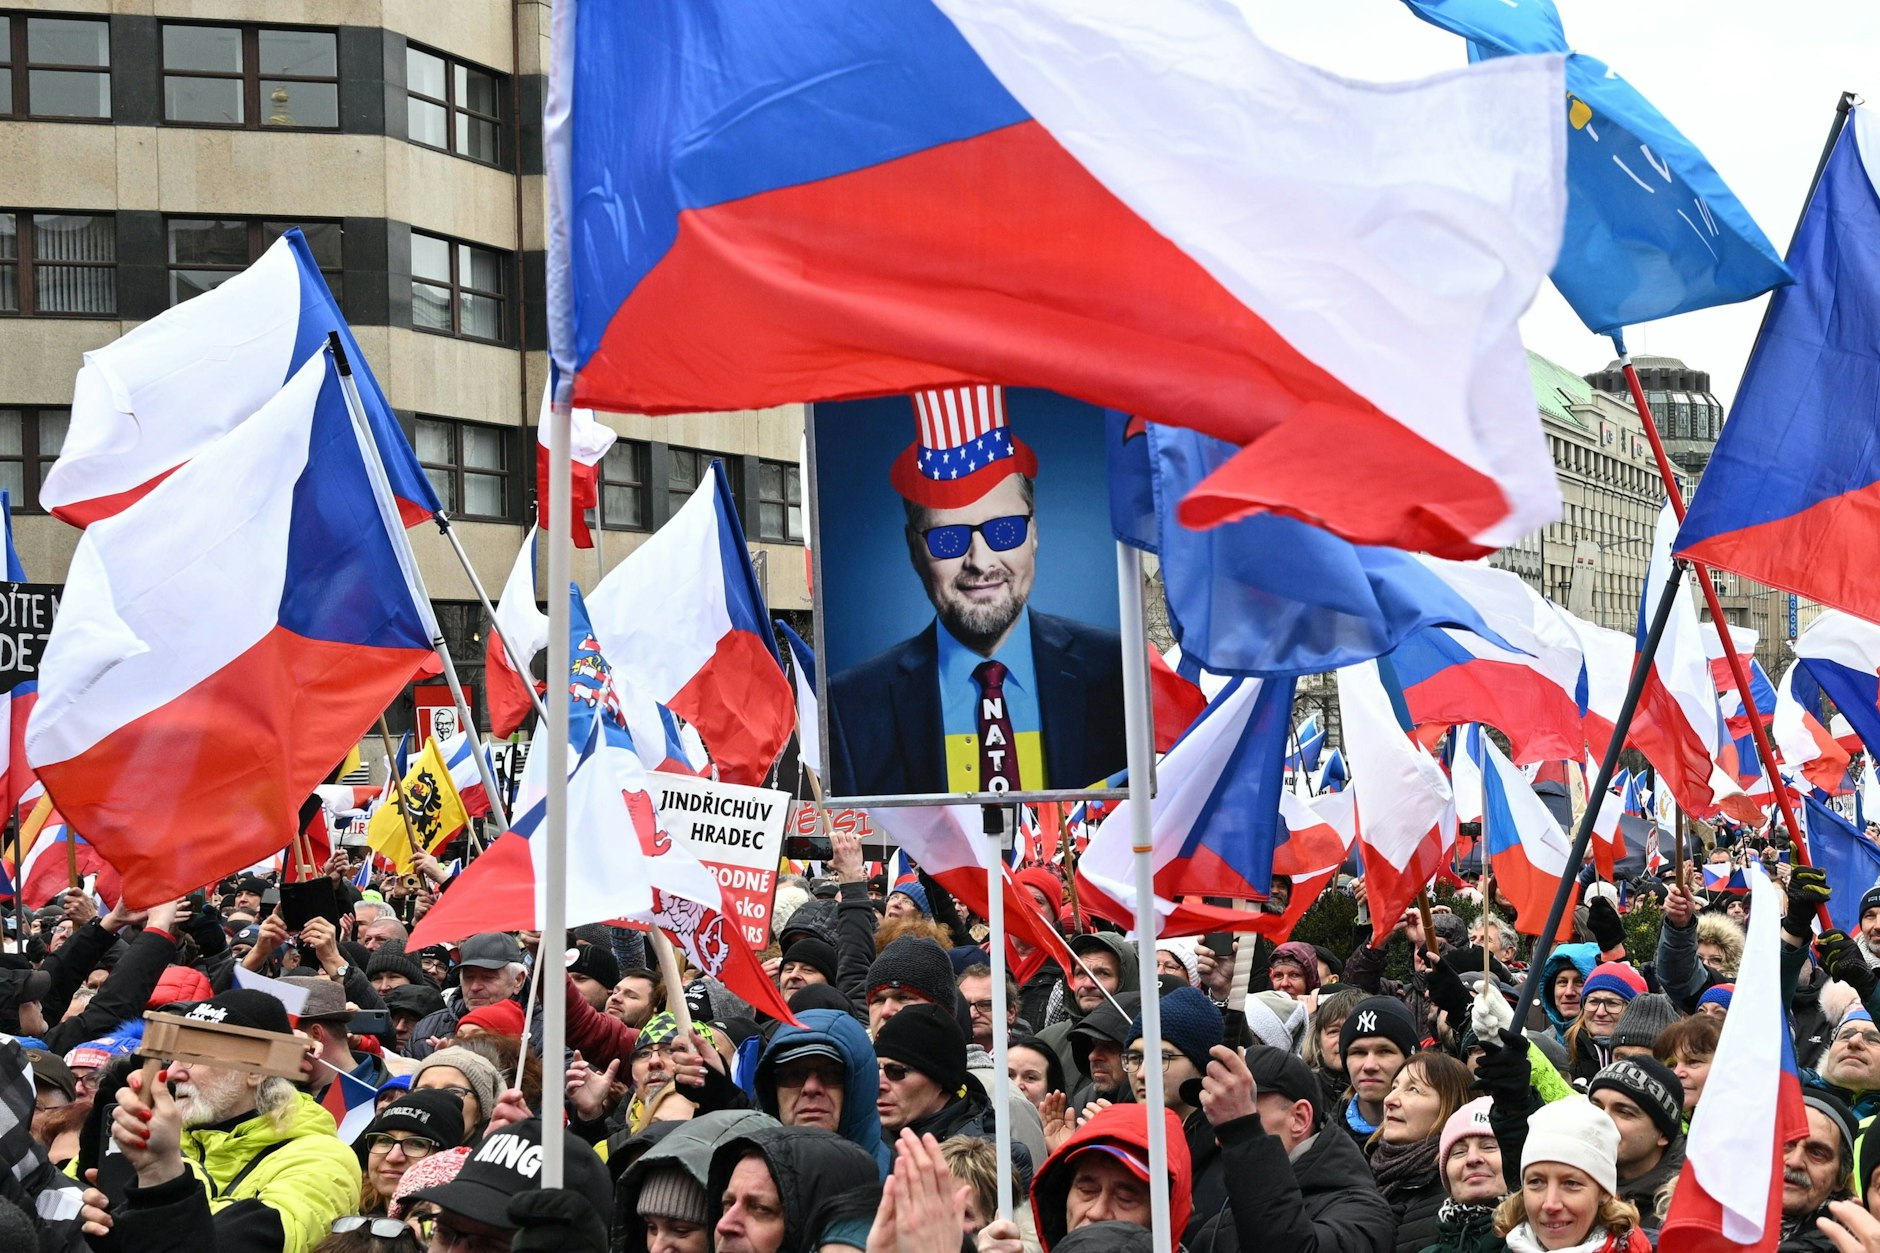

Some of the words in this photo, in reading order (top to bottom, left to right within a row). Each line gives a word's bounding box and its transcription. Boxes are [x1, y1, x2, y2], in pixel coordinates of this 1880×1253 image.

[983, 698, 1010, 792] NATO
[659, 790, 773, 822] JINDŘICHŮV
[690, 822, 765, 850] HRADEC
[1356, 1010, 1378, 1032] NY
[473, 1133, 543, 1179] KING
